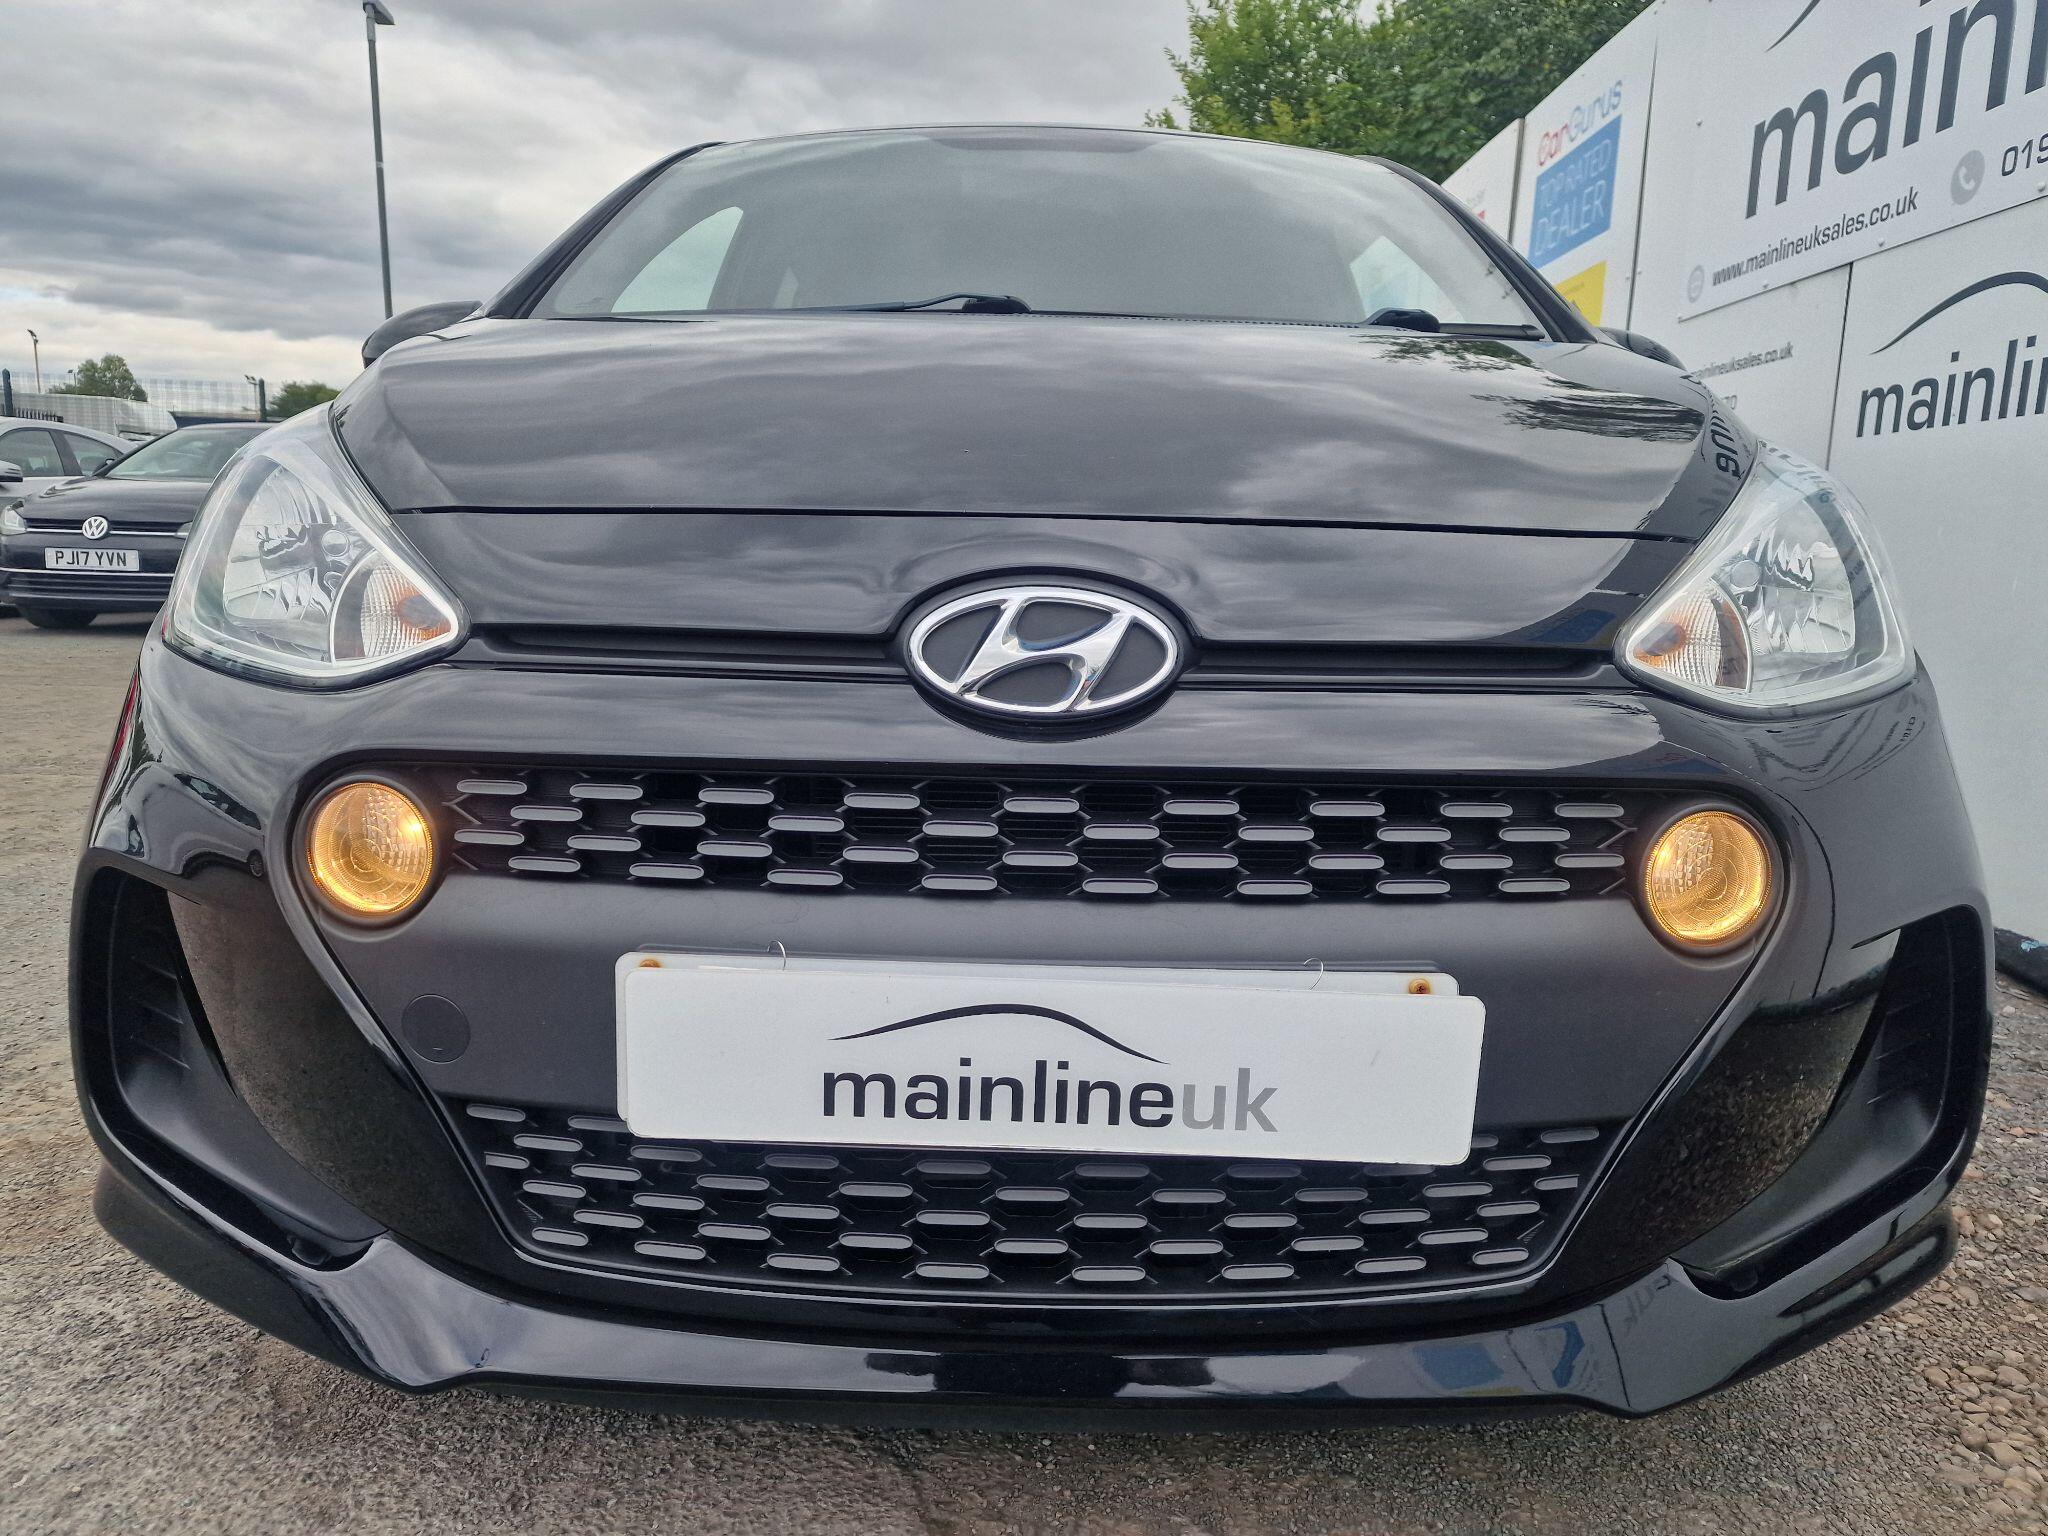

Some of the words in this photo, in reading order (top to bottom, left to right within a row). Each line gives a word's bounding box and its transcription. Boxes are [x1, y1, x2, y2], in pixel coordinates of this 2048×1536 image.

[1537, 79, 1623, 166] CarGurus
[1564, 139, 1612, 195] RATED
[1534, 179, 1607, 256] DEALER
[1712, 185, 1920, 286] www.mainlineuksales.co.uk
[55, 550, 90, 566] PJ17
[94, 551, 127, 567] YVN
[823, 1056, 1279, 1133] mainlineuk
